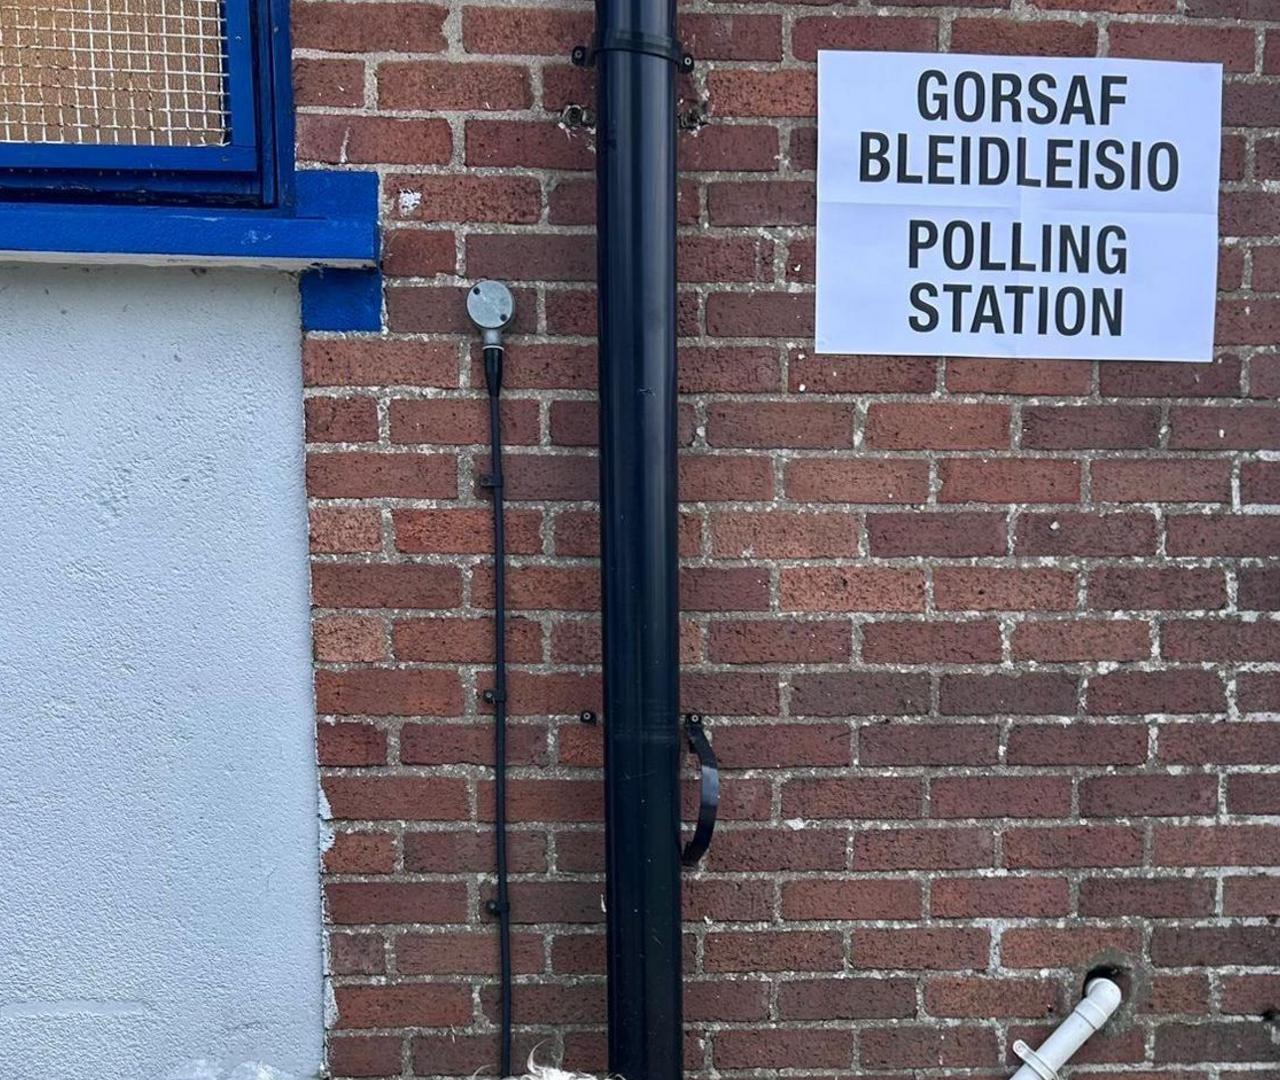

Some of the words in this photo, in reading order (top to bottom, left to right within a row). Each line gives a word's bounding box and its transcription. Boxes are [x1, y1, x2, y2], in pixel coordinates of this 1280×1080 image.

[917, 69, 1128, 126] GORSAF
[859, 131, 1179, 192] BLEIDLEISIO
[908, 219, 1127, 275] POLLING
[908, 282, 1123, 337] STATION
